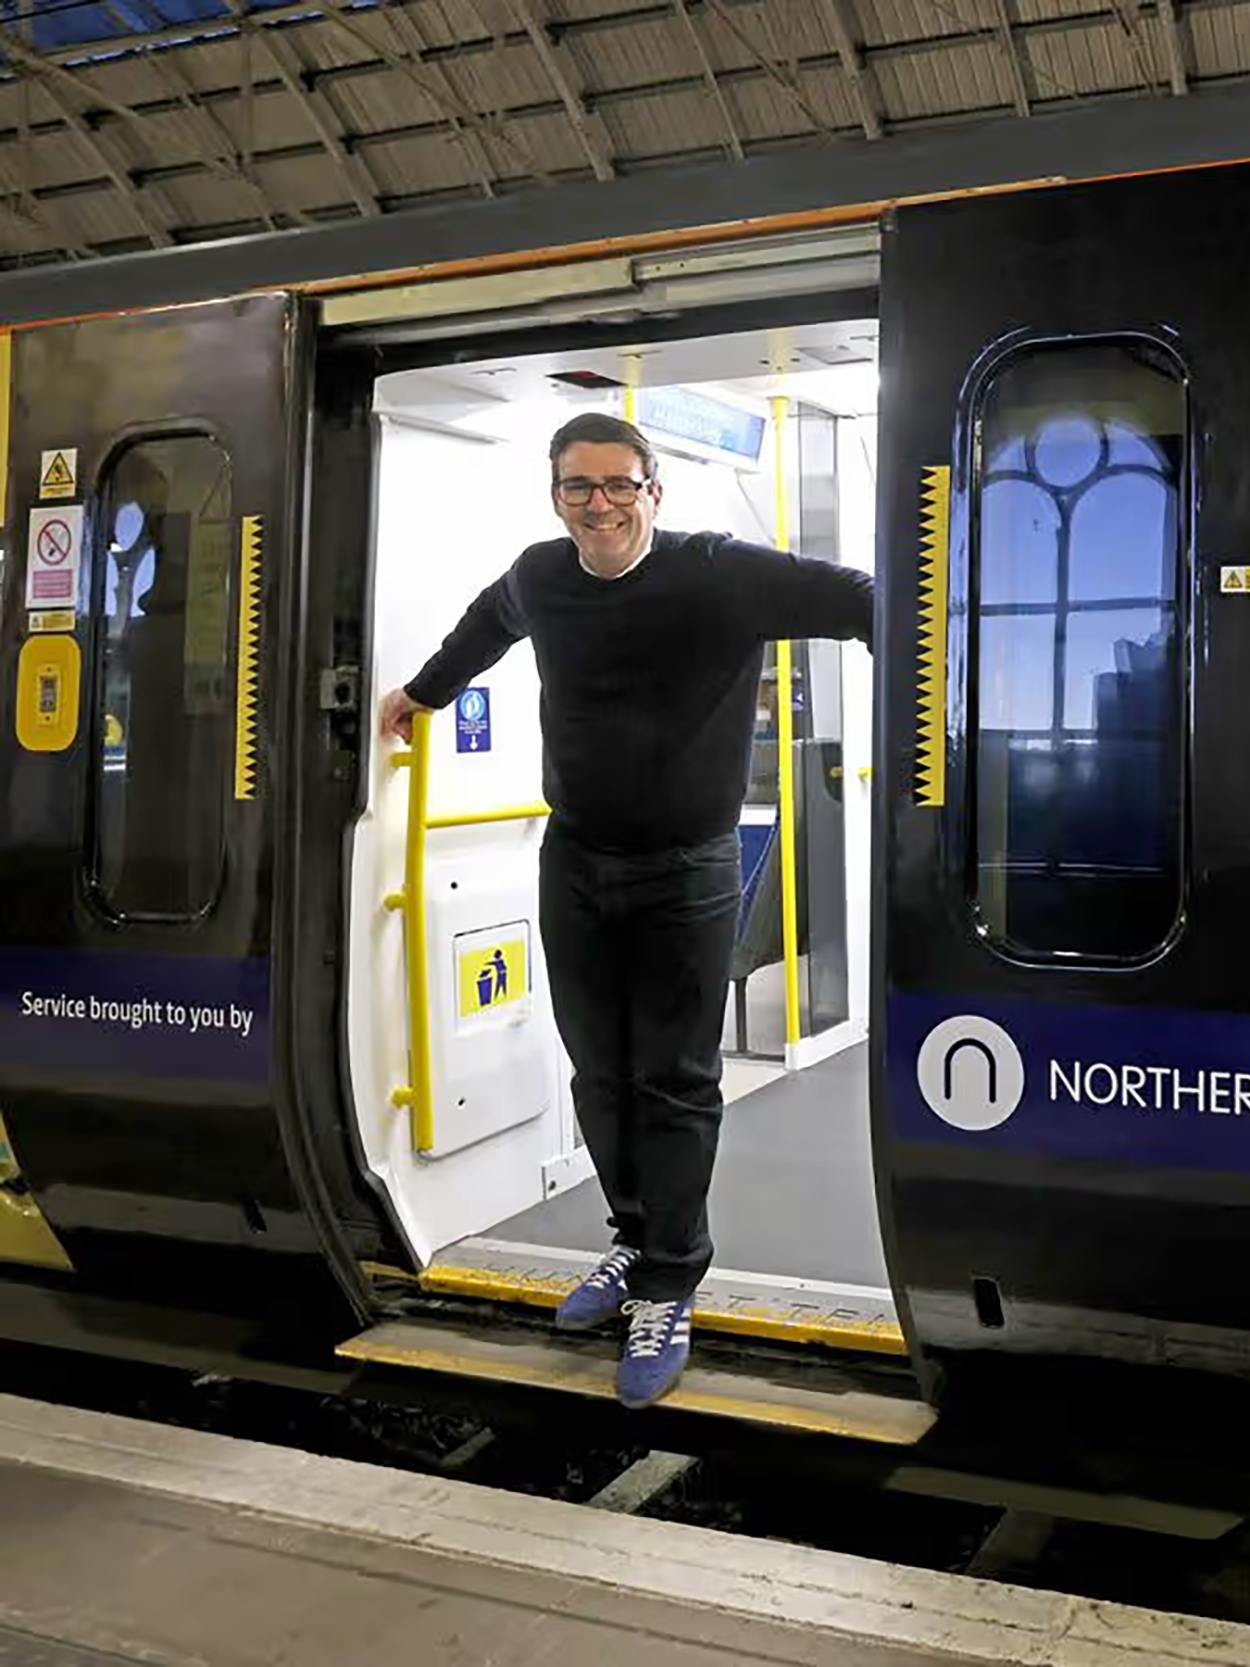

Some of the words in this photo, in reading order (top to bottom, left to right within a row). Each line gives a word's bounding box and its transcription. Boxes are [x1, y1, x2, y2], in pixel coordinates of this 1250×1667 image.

[21, 991, 86, 1018] Service
[90, 995, 163, 1029] brought
[166, 1001, 187, 1024] to
[190, 1006, 225, 1032] you
[230, 1004, 254, 1037] by
